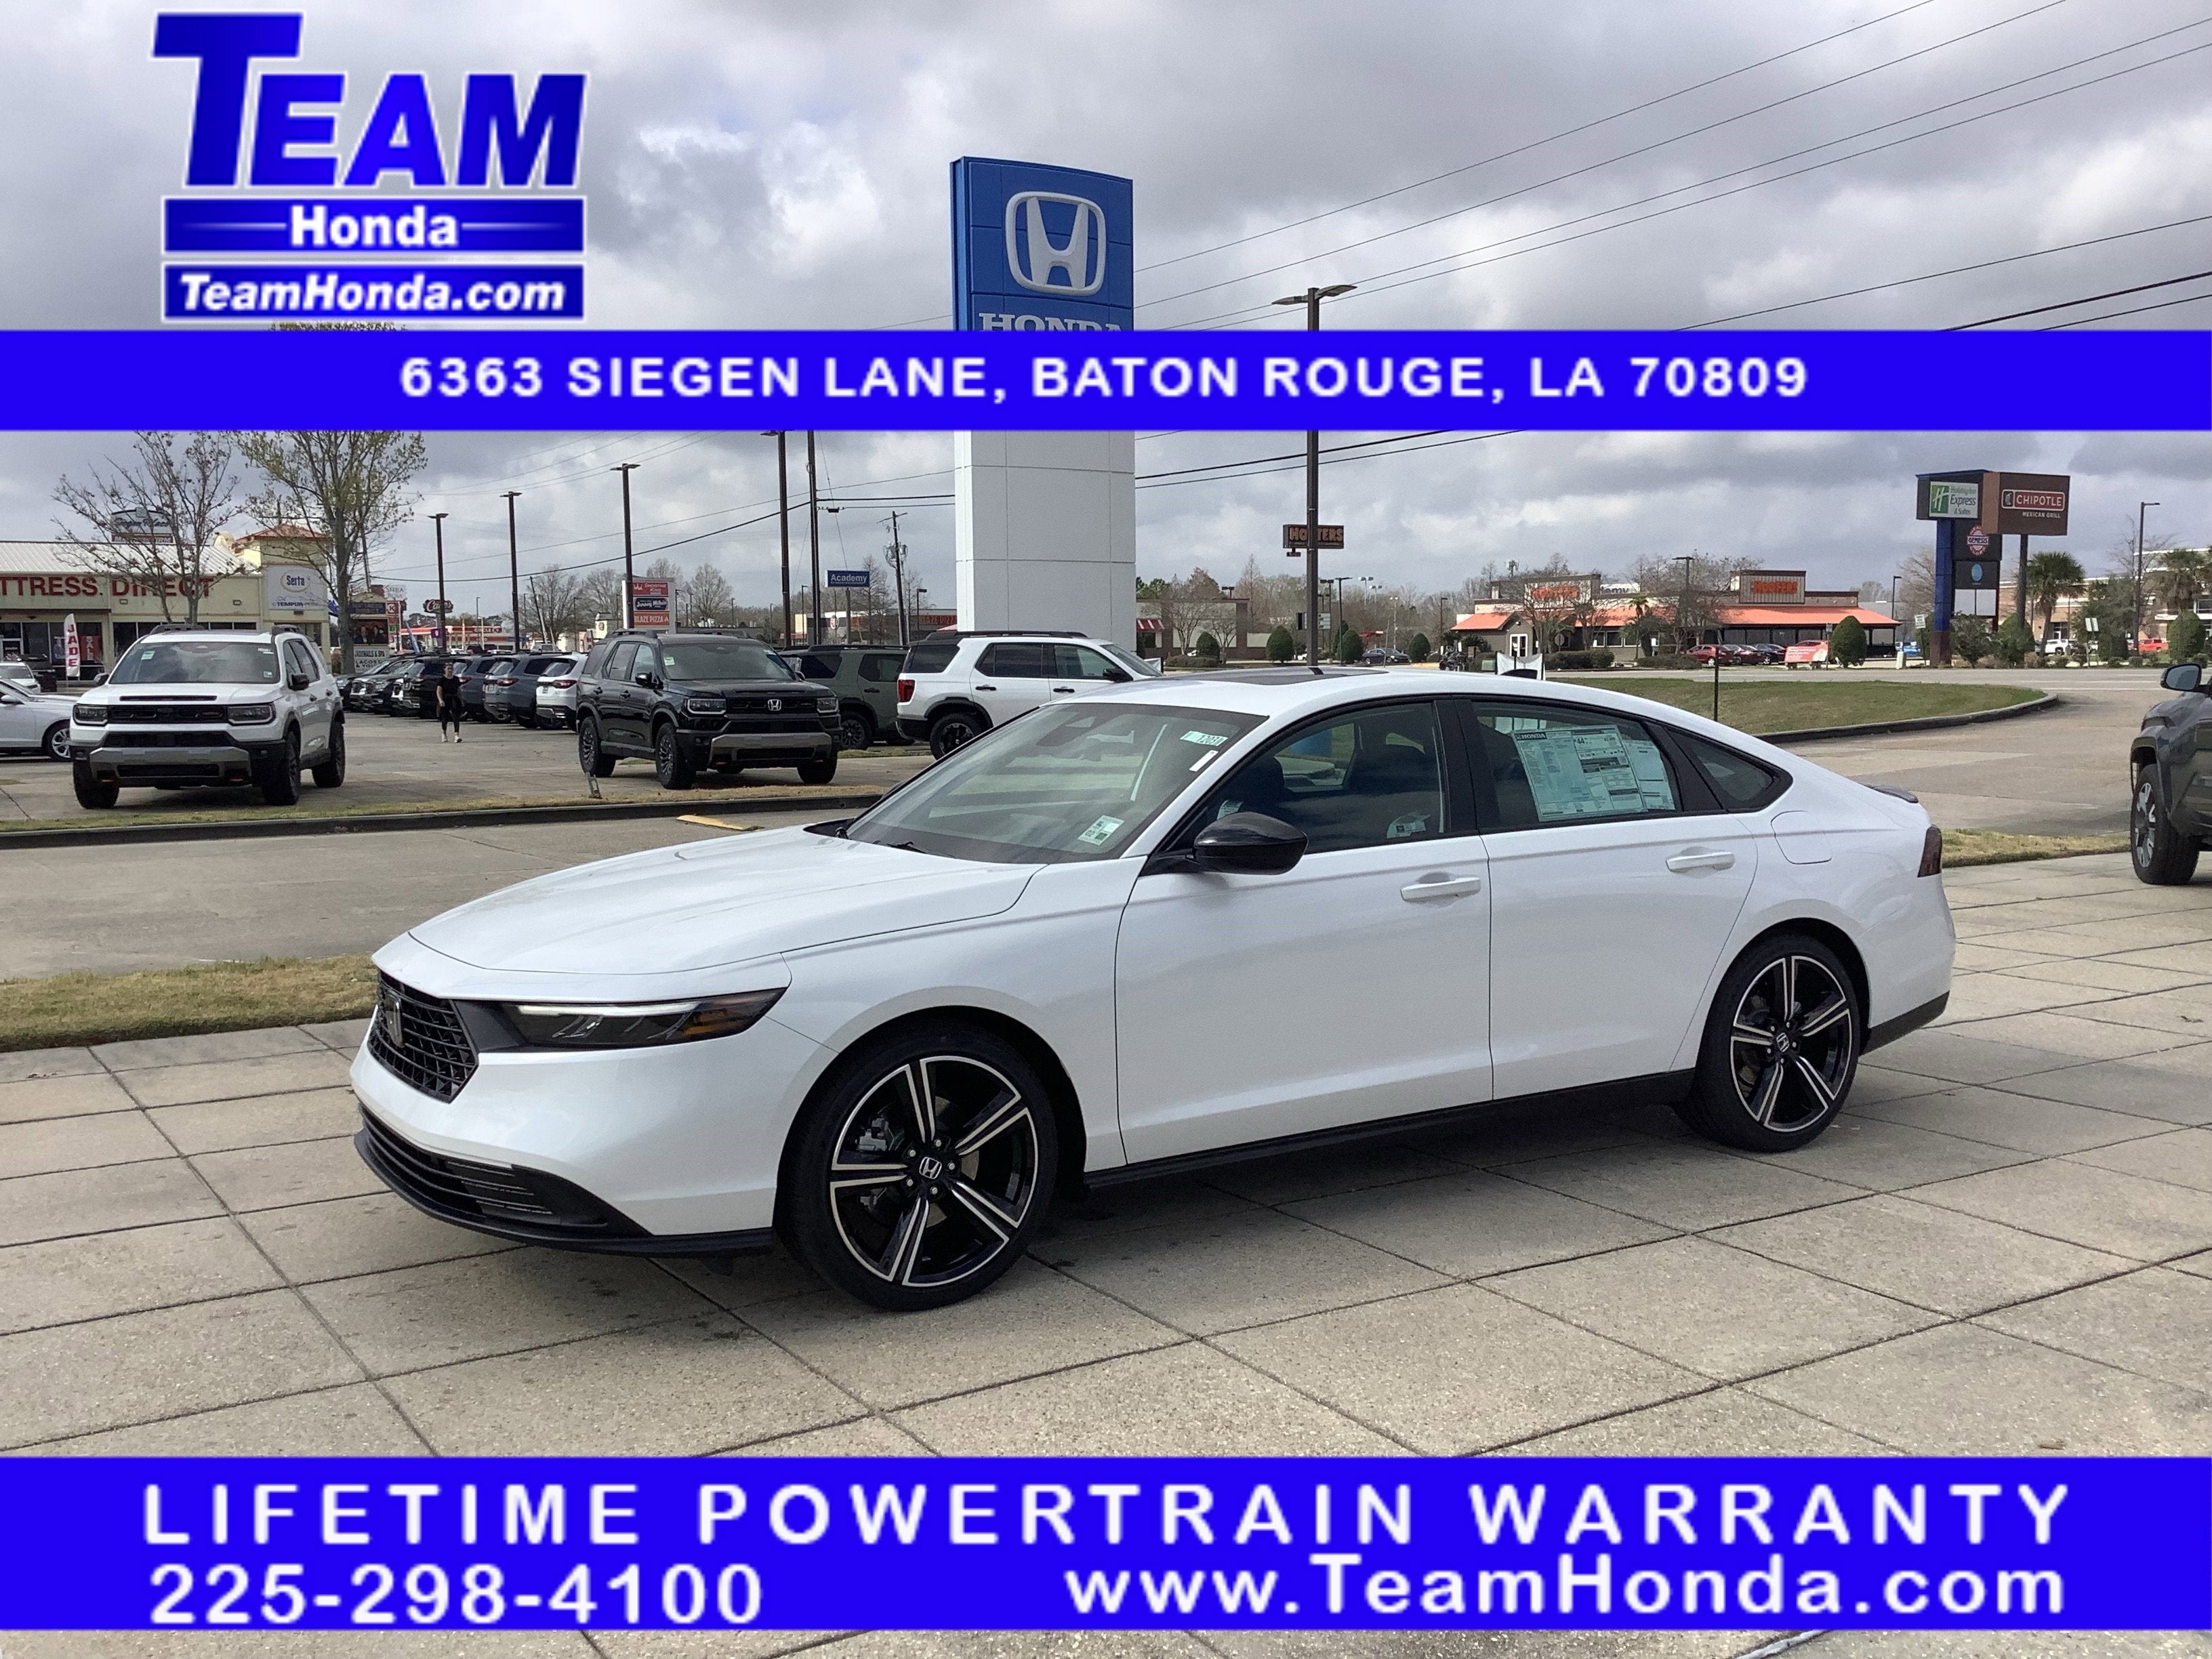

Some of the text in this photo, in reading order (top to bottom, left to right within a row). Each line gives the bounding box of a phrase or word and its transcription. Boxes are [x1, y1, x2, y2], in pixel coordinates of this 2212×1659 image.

[1950, 494, 1977, 508] Express
[2016, 495, 2062, 506] CHIPOTLE
[1289, 527, 1343, 541] HOTERS
[287, 575, 305, 586] Serta
[831, 573, 867, 583] Academy
[68, 624, 79, 667] JADE
